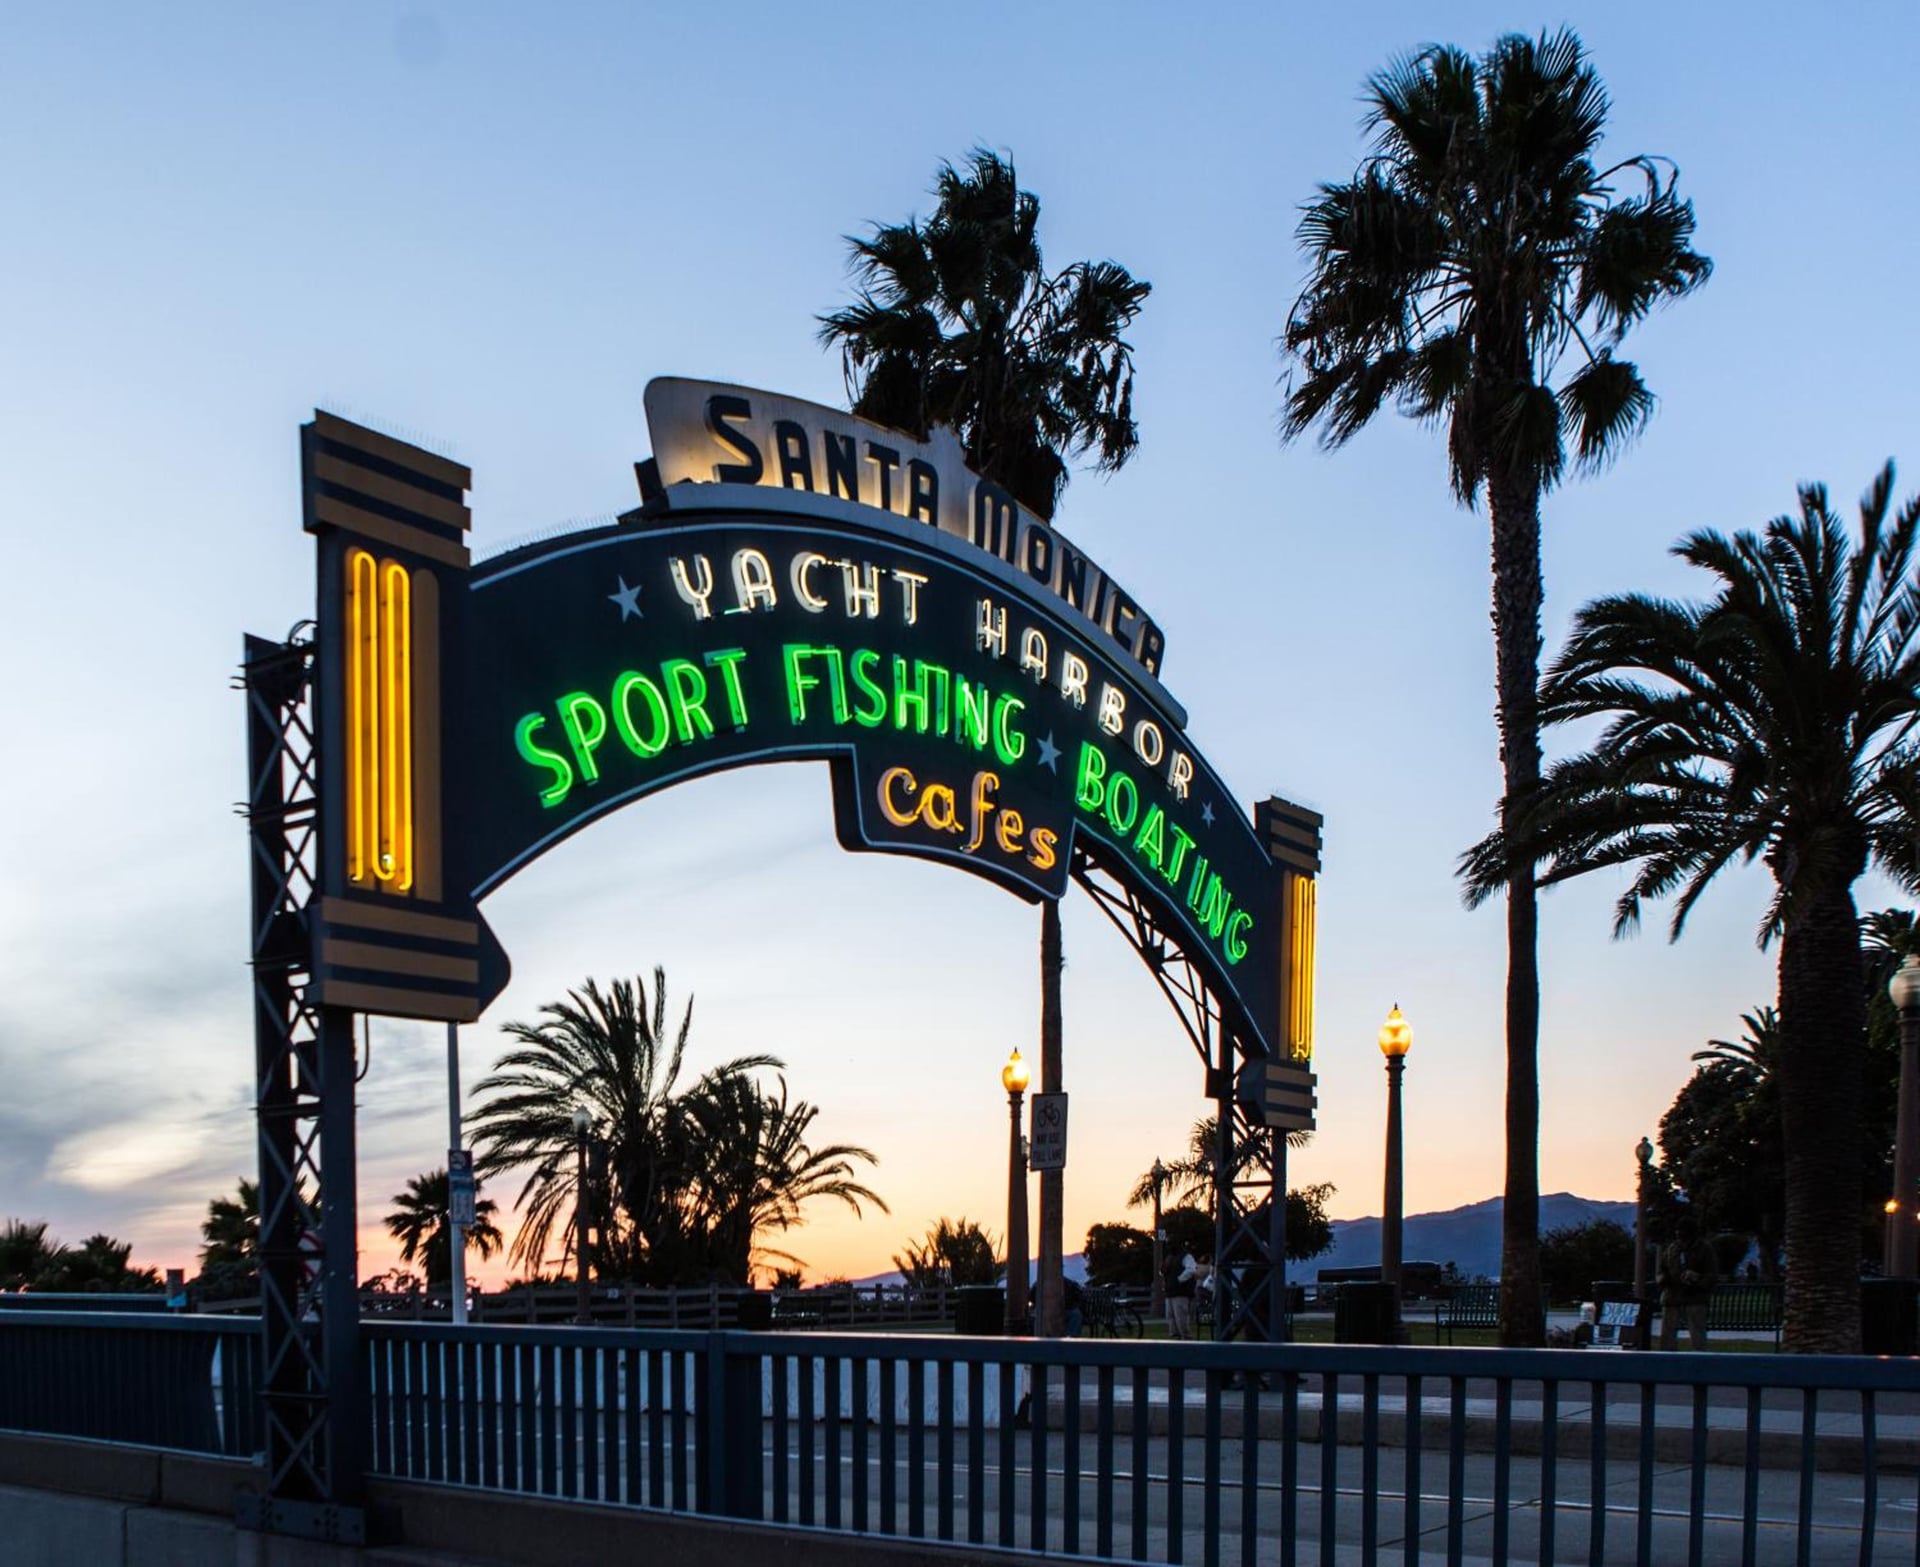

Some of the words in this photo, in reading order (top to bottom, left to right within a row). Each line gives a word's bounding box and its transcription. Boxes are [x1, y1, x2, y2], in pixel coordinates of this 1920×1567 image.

[705, 394, 940, 528] SANTA
[970, 478, 1166, 680] MONICA
[515, 647, 748, 809] SPORT
[782, 643, 1026, 765] FISHING
[1075, 740, 1254, 965] BOATING
[669, 547, 928, 626] YACHT
[976, 598, 1194, 803] HARBOR
[877, 767, 1059, 871] Cafes
